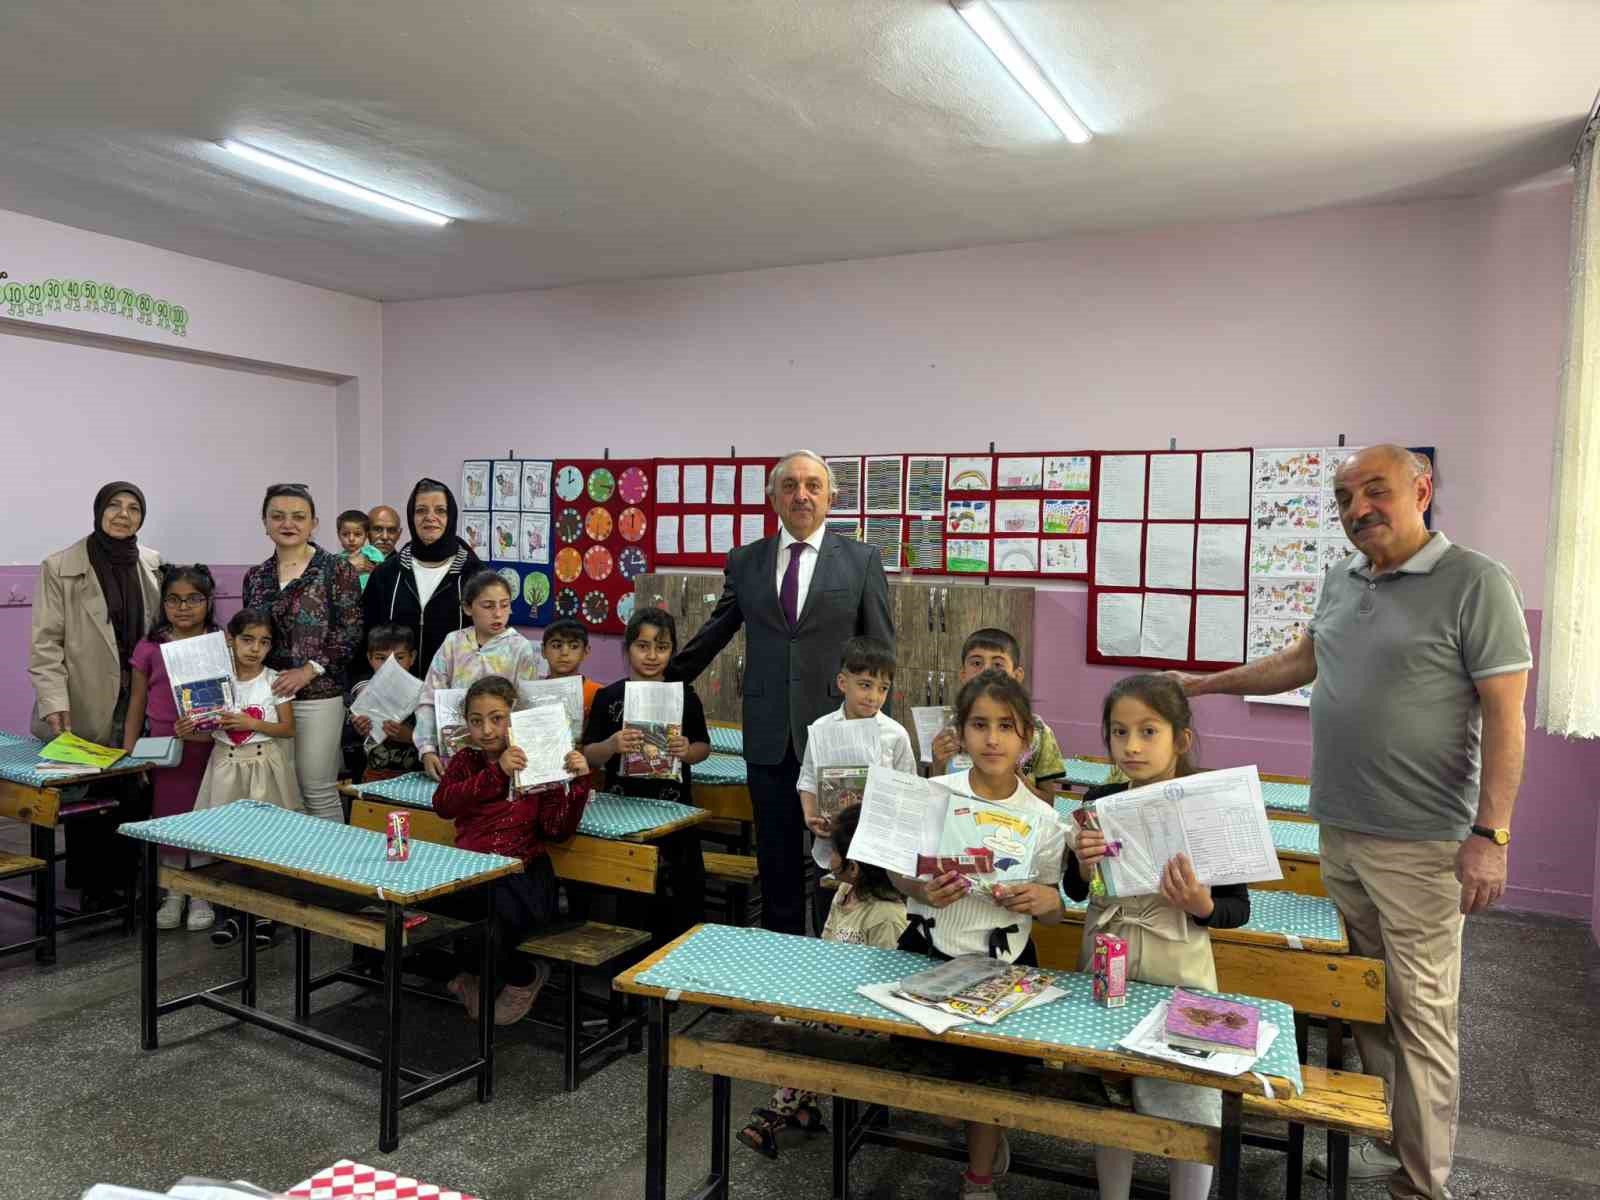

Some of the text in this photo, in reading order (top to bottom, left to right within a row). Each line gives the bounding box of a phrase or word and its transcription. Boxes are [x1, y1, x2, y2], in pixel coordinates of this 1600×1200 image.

[9, 287, 21, 303] 10
[29, 285, 41, 301] 20
[47, 282, 60, 298] 30
[67, 282, 79, 297] 40
[85, 284, 96, 299] 50
[103, 286, 115, 301] 60
[123, 290, 133, 306] 70
[157, 303, 168, 318] 90
